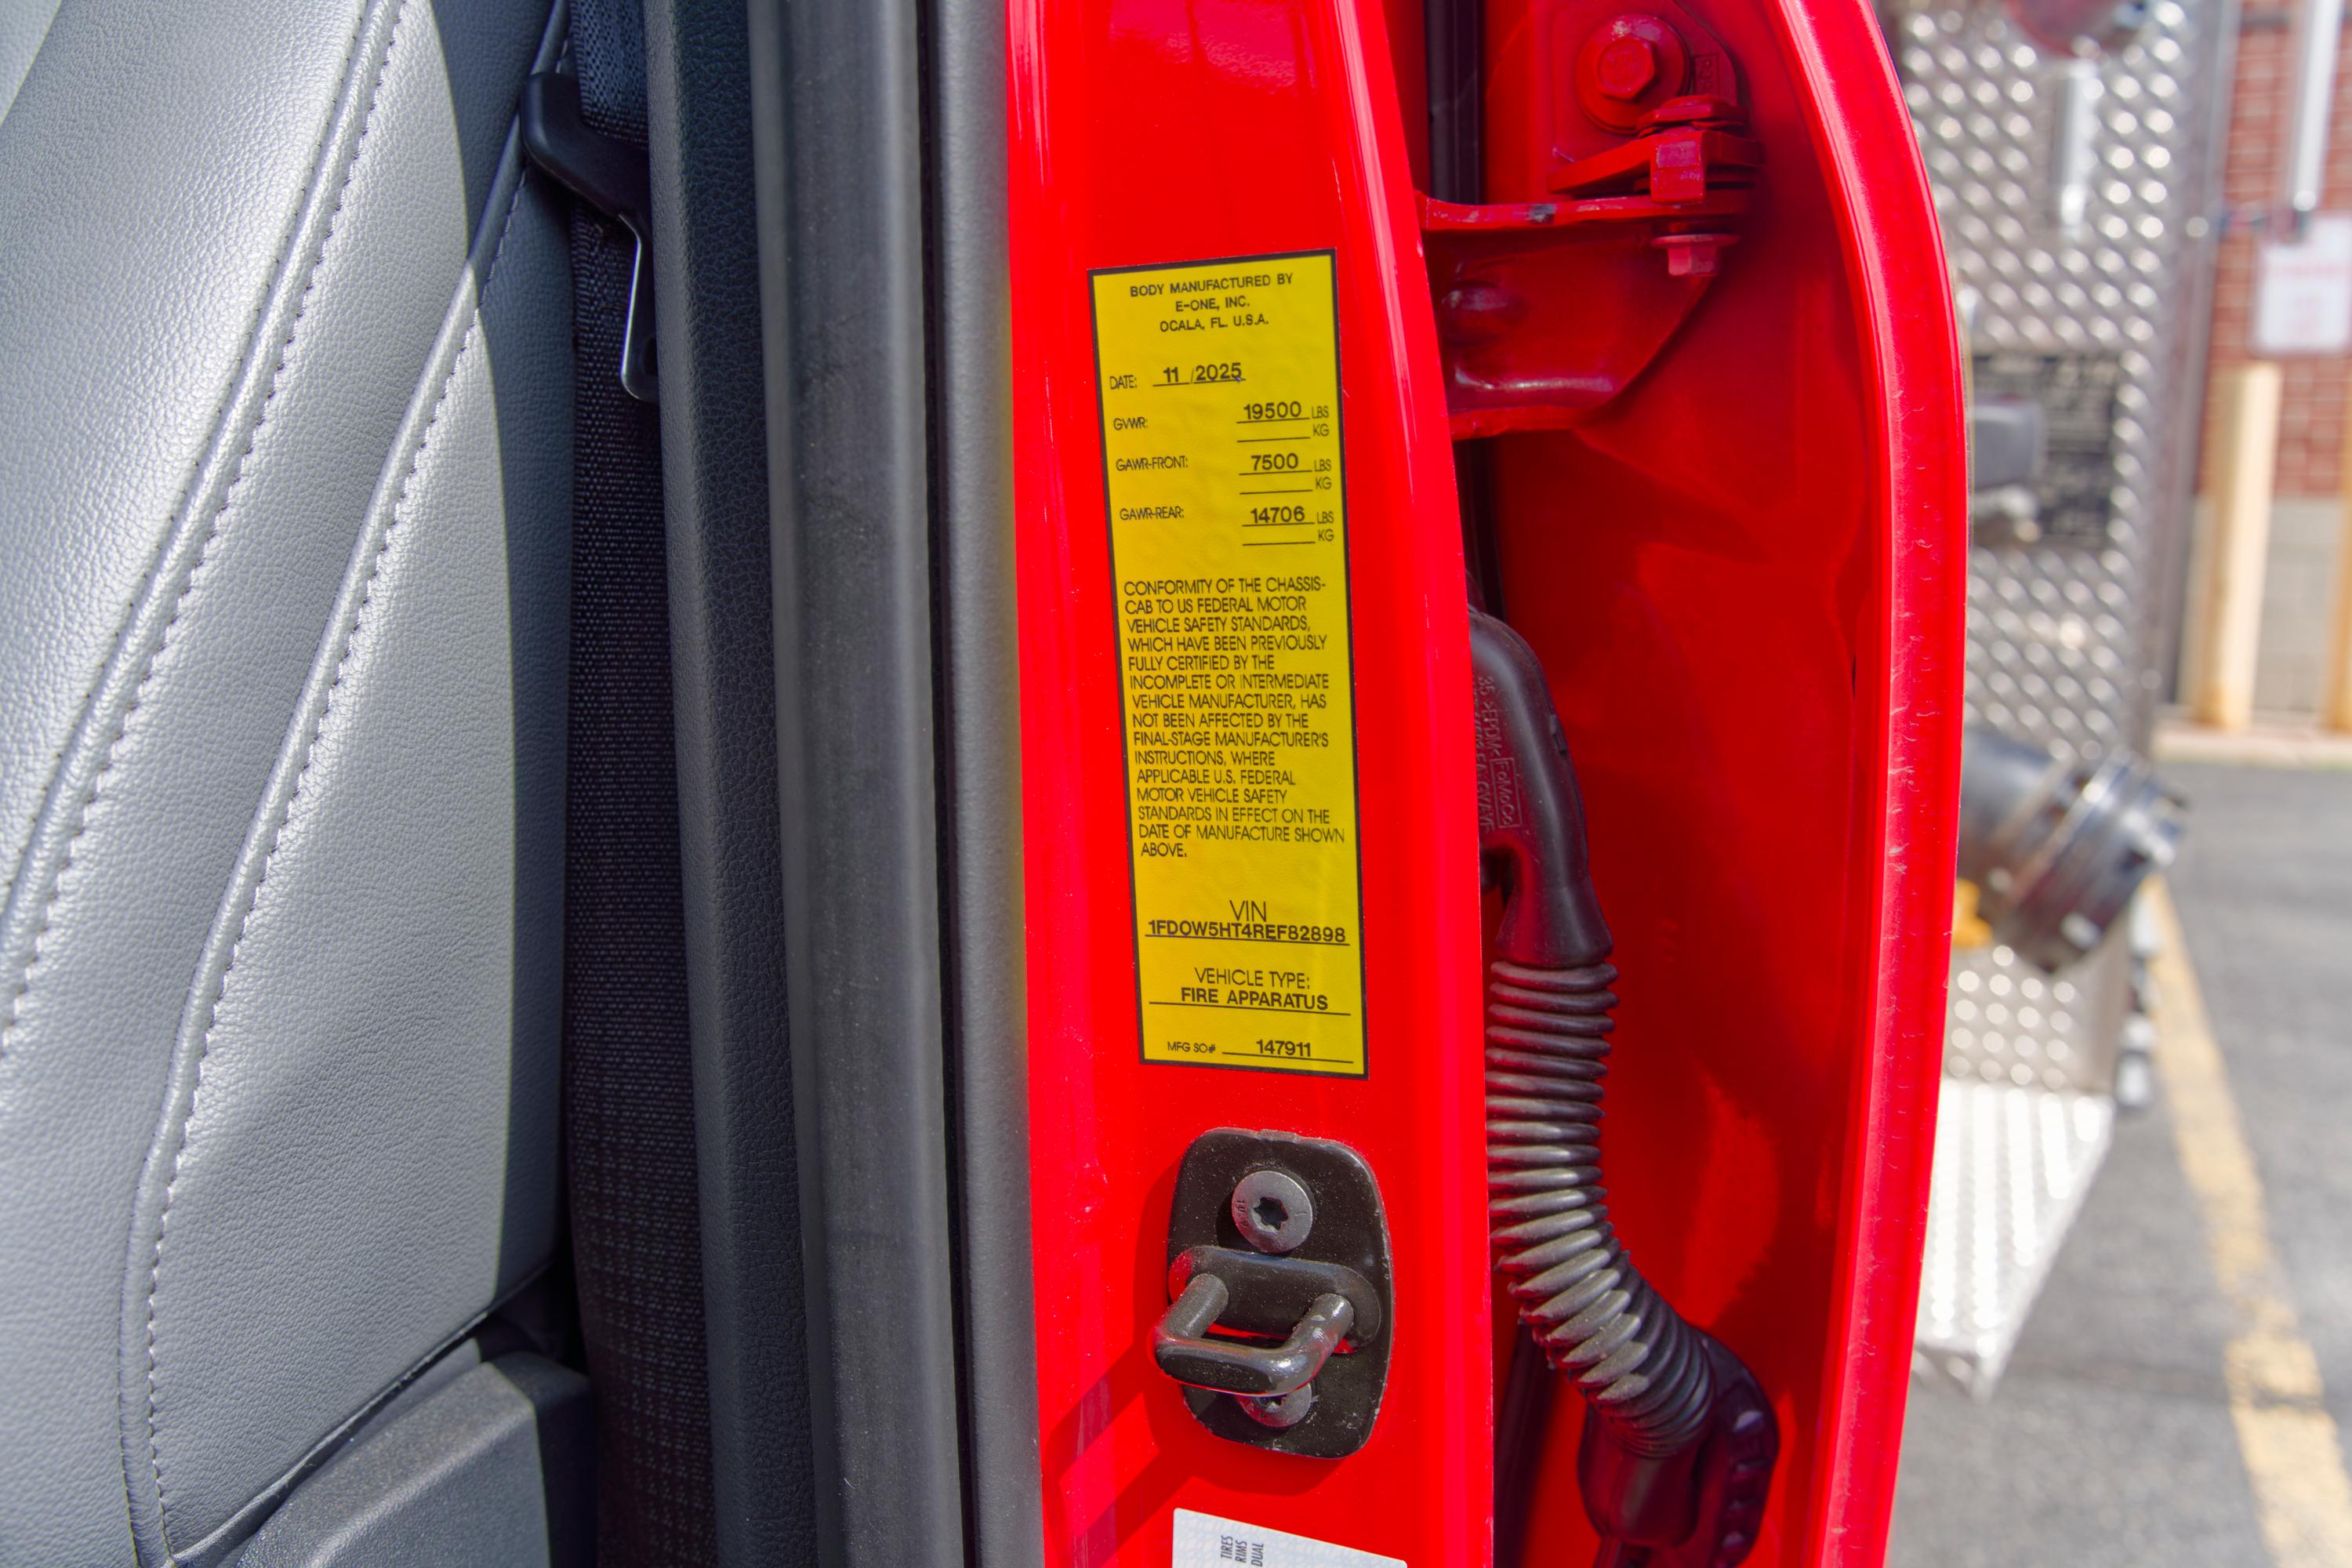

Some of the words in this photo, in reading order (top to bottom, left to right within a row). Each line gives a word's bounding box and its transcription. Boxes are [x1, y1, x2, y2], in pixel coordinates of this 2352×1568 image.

[1131, 284, 1163, 297] BODY
[1171, 275, 1270, 293] MANUFACTURED
[1278, 274, 1292, 285] BY
[1176, 298, 1219, 311] E-ONE,
[1225, 296, 1250, 307] INC.
[1160, 319, 1204, 332] OCALA,
[1233, 314, 1269, 326] U.S.A.
[1110, 375, 1137, 390] DATE:
[1163, 367, 1178, 383] 11
[1113, 417, 1148, 430] GVWR:
[1243, 401, 1301, 419] 19500
[1312, 405, 1329, 419] LBS
[1313, 423, 1329, 437] KG
[1116, 456, 1188, 471] GAWR-FRONT:
[1251, 453, 1298, 470] 7500
[1315, 459, 1331, 472] LBS
[1316, 477, 1331, 489] KG
[1120, 506, 1184, 521] GAWR-REAR:
[1251, 506, 1305, 524] 14706
[1317, 511, 1334, 524] LBS
[1319, 529, 1334, 542] KG
[1124, 579, 1212, 596] CONFORMITY
[1216, 579, 1234, 593] OF
[1239, 578, 1261, 592] THE
[1266, 576, 1325, 592] CHASSIS-
[1125, 600, 1152, 614] CAB
[1156, 599, 1173, 613] TO
[1178, 599, 1192, 613] US
[1198, 597, 1253, 612] FEDERAL
[1258, 596, 1305, 612] MOTOR
[1127, 618, 1180, 633] VEHICLE
[1185, 617, 1227, 632] SAFETY
[1232, 615, 1309, 631] STANDARDS,
[1127, 637, 1172, 652] WHICH
[1177, 637, 1209, 651] HAVE
[1214, 636, 1246, 651] BEEN
[1251, 634, 1327, 650] PREVIOUSLY
[1129, 656, 1163, 671] FULLY
[1167, 655, 1229, 670] CERTIFIED
[1234, 655, 1248, 670] BY
[1252, 655, 1274, 670] THE
[1131, 674, 1210, 689] INCOMPLETE
[1216, 674, 1235, 689] OR
[1240, 673, 1329, 688] INTERMEDIATE
[1132, 694, 1184, 709] VEHICLE
[1189, 694, 1295, 709] MANUFACTURER,
[1301, 694, 1326, 708] HAS
[1133, 713, 1158, 728] NOT
[1163, 713, 1194, 728] BEEN
[1200, 713, 1263, 728] AFFECTED
[1268, 713, 1282, 728] BY
[1286, 713, 1308, 728] THE
[1134, 731, 1210, 746] FINAL-STAGE
[1215, 731, 1328, 747] MANUFACTURER'S
[1135, 750, 1225, 766] INSTRUCTIONS,
[1231, 751, 1275, 765] WHERE
[1138, 769, 1210, 783] APPLICABLE
[1214, 769, 1235, 784] U.S.
[1241, 770, 1295, 785] FEDERAL
[1138, 788, 1184, 801] MOTOR
[1188, 788, 1239, 803] VEHICLE
[1244, 789, 1287, 804] SAFETY
[1495, 761, 1515, 825] FoMoCo
[1138, 806, 1211, 821] STANDARDS
[1216, 808, 1228, 821] IN
[1232, 808, 1277, 822] EFFECT
[1282, 809, 1303, 823] ON
[1308, 809, 1330, 824] THE
[1139, 824, 1169, 838] DATE
[1174, 824, 1191, 838] OF
[1196, 825, 1290, 841] MANUFACTURE
[1295, 827, 1344, 842] SHOWN
[1142, 843, 1186, 857] ABOVE.
[1229, 900, 1266, 922] VIN
[1195, 967, 1263, 986] VEHICLE
[1269, 971, 1309, 989] TYPE:
[1181, 987, 1218, 1003] FIRE
[1227, 990, 1328, 1011] APPARATUS
[1168, 1041, 1190, 1052] MFG
[1194, 1043, 1216, 1053] SO#
[1257, 1040, 1311, 1057] 147911
[1221, 1535, 1233, 1559] TIRES
[1235, 1540, 1247, 1563] RIMS
[1250, 1543, 1264, 1566] DUAL
